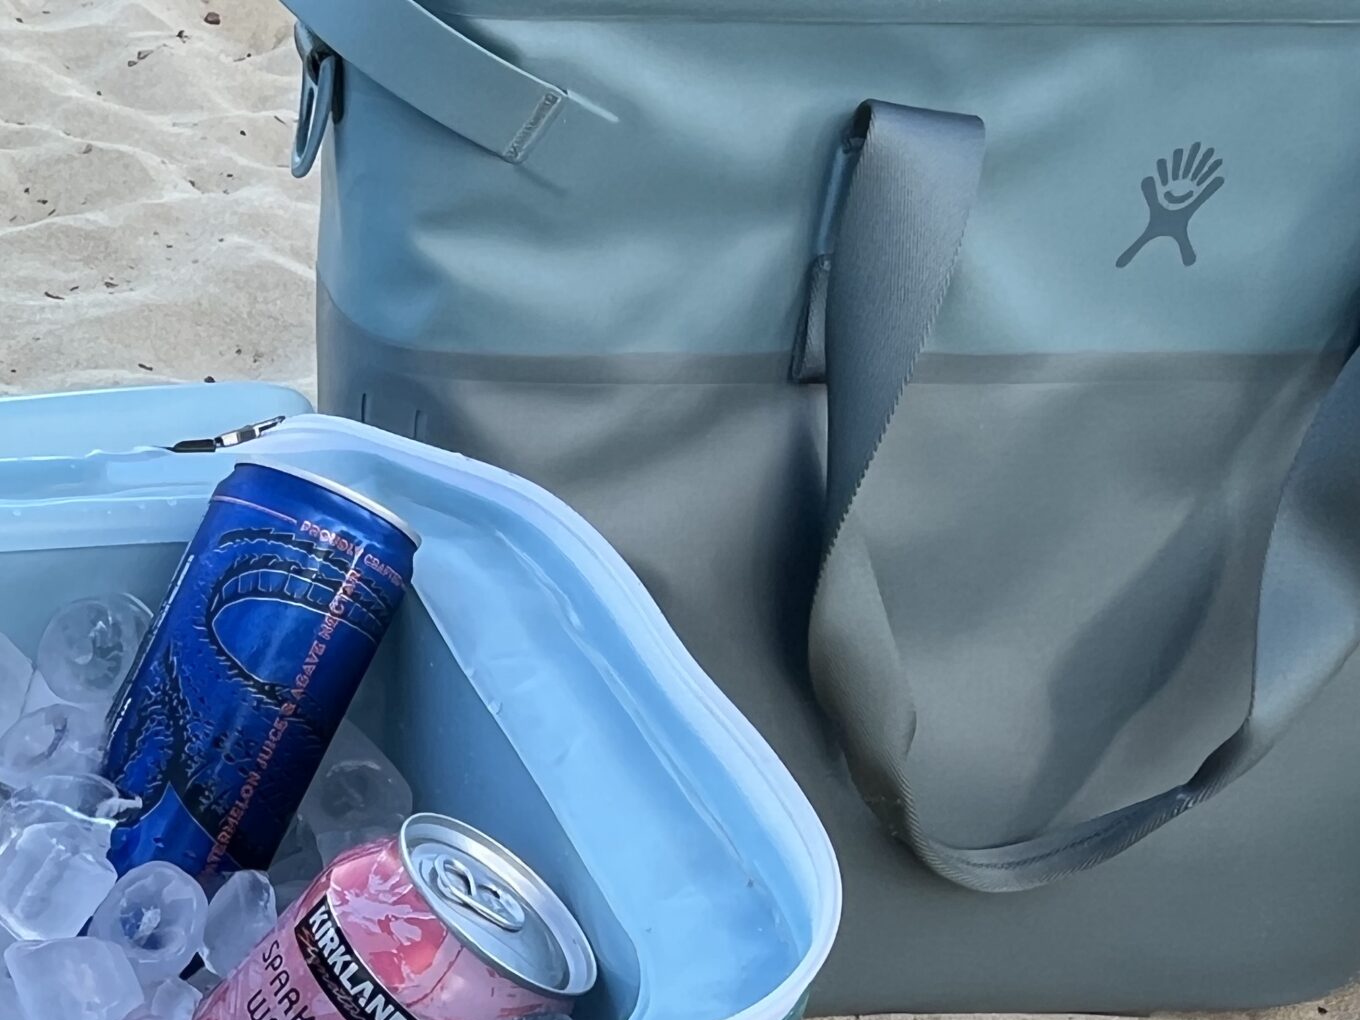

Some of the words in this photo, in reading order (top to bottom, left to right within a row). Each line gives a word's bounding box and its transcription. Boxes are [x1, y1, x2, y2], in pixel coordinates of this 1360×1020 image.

[200, 771, 261, 878] ATERMELON
[257, 717, 288, 769] JUICE
[291, 640, 327, 699] AGAVE
[318, 569, 362, 641] NECTAR
